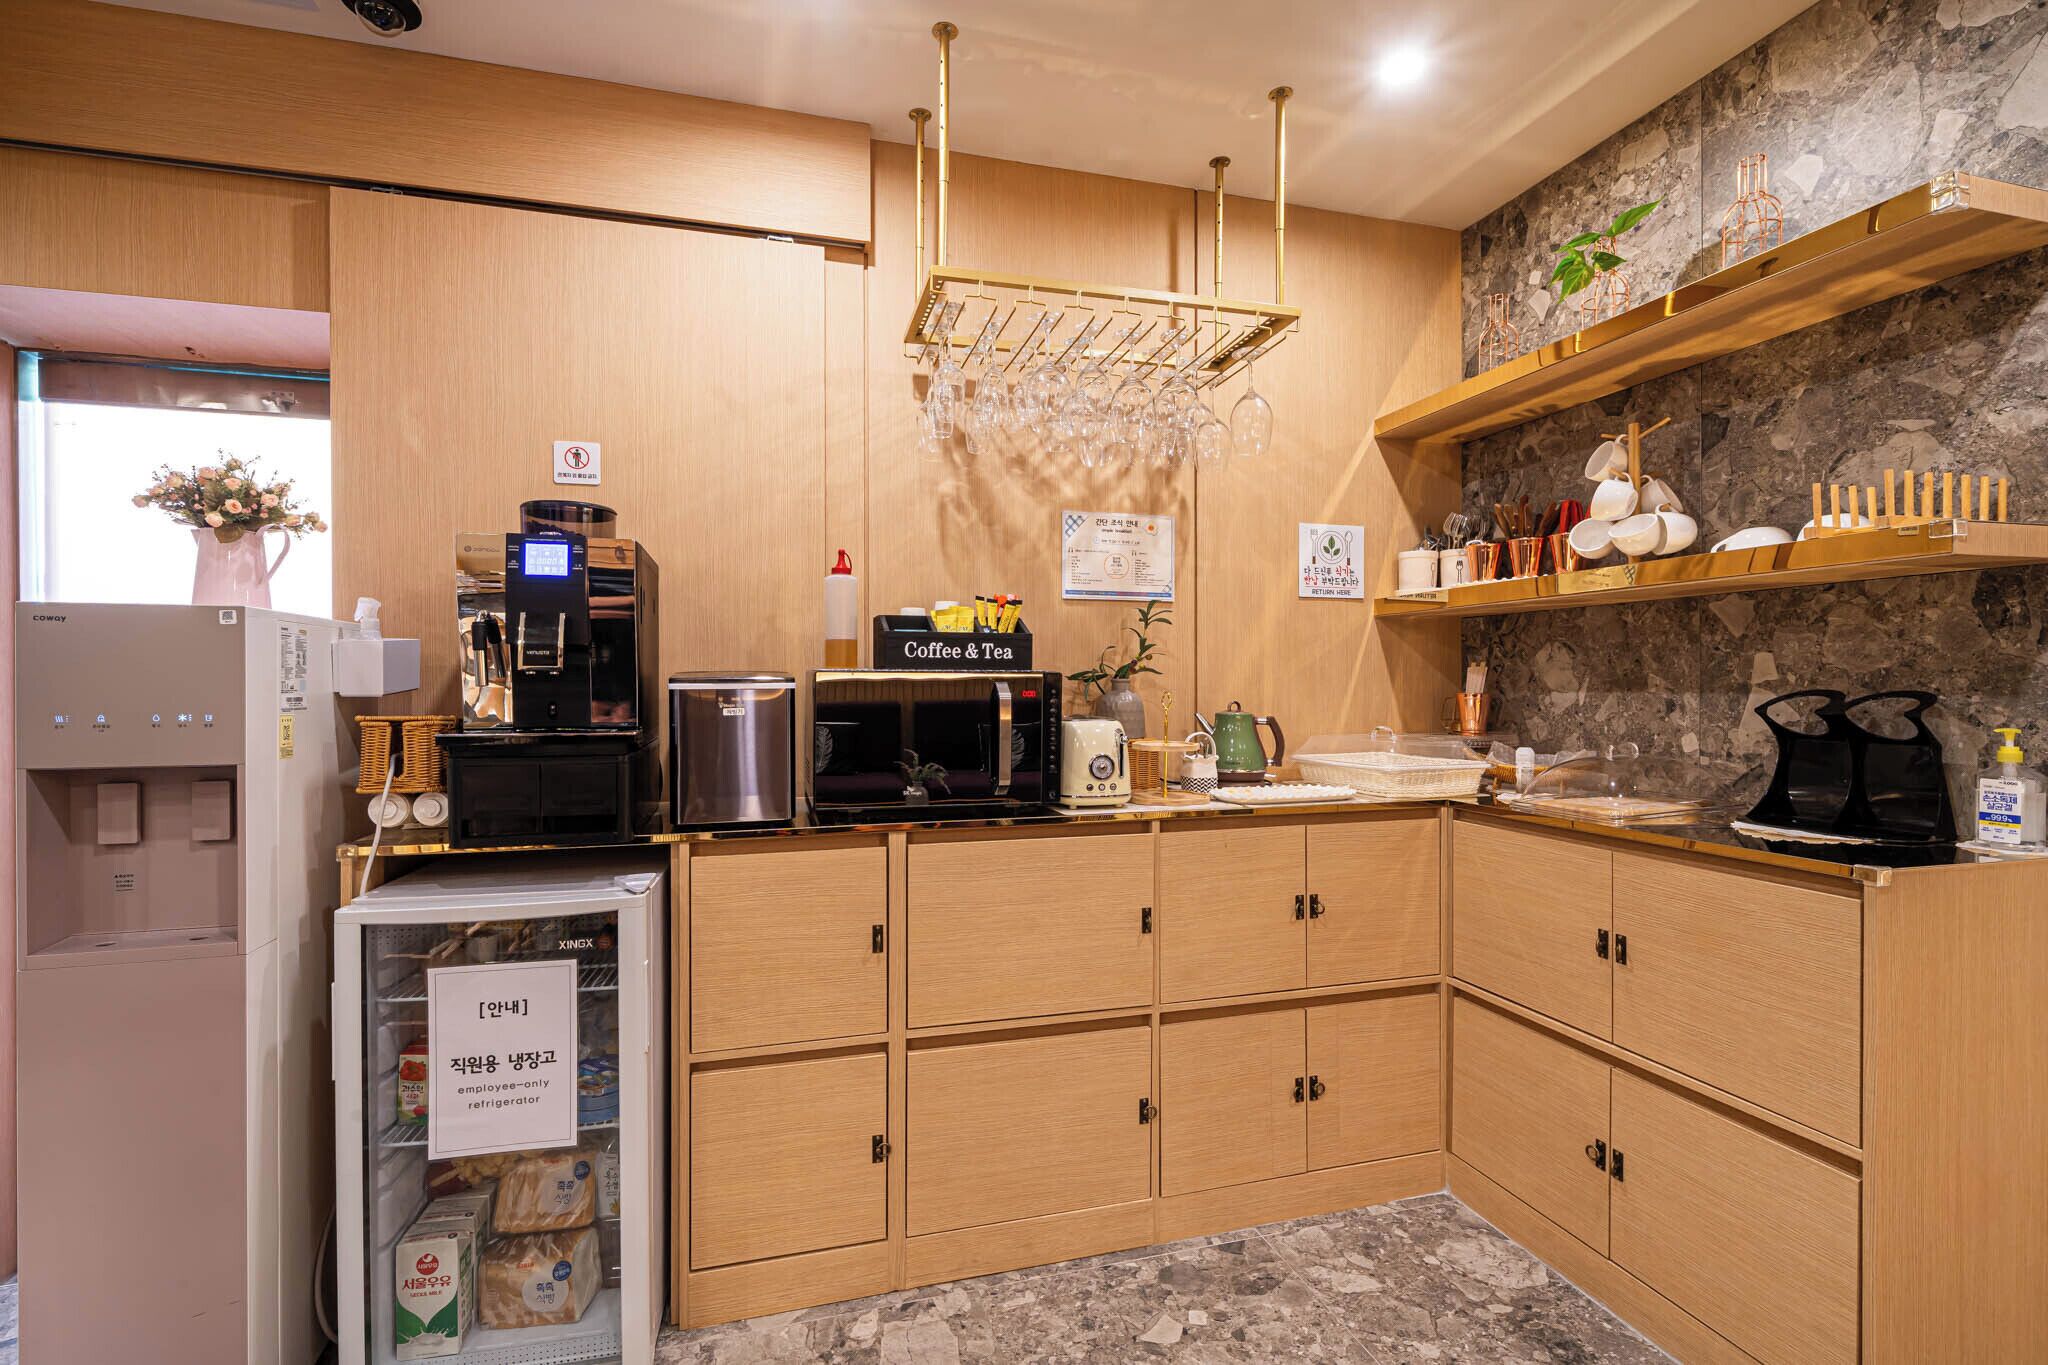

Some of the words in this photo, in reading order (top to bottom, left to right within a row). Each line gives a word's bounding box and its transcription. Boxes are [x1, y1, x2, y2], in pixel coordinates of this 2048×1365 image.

[1095, 518, 1107, 526] 간단
[1111, 519, 1123, 527] 조식
[1126, 520, 1138, 528] 안내
[1304, 566, 1311, 576] 다
[1336, 565, 1355, 577] 식기는
[1304, 576, 1319, 586] 반납
[1321, 576, 1359, 587] 부탁드립니다
[1311, 588, 1335, 596] RETURN
[32, 614, 67, 623] coway
[904, 641, 962, 659] Coffee
[965, 642, 979, 659] &
[981, 642, 1013, 660] Tea
[559, 938, 593, 950] XINGX
[479, 998, 528, 1019] [안내]
[450, 1054, 500, 1075] 직원용
[508, 1050, 557, 1071] 냉장고
[457, 1078, 550, 1095] employee-only
[468, 1095, 541, 1110] refrigerator
[402, 1275, 452, 1290] 서울우유
